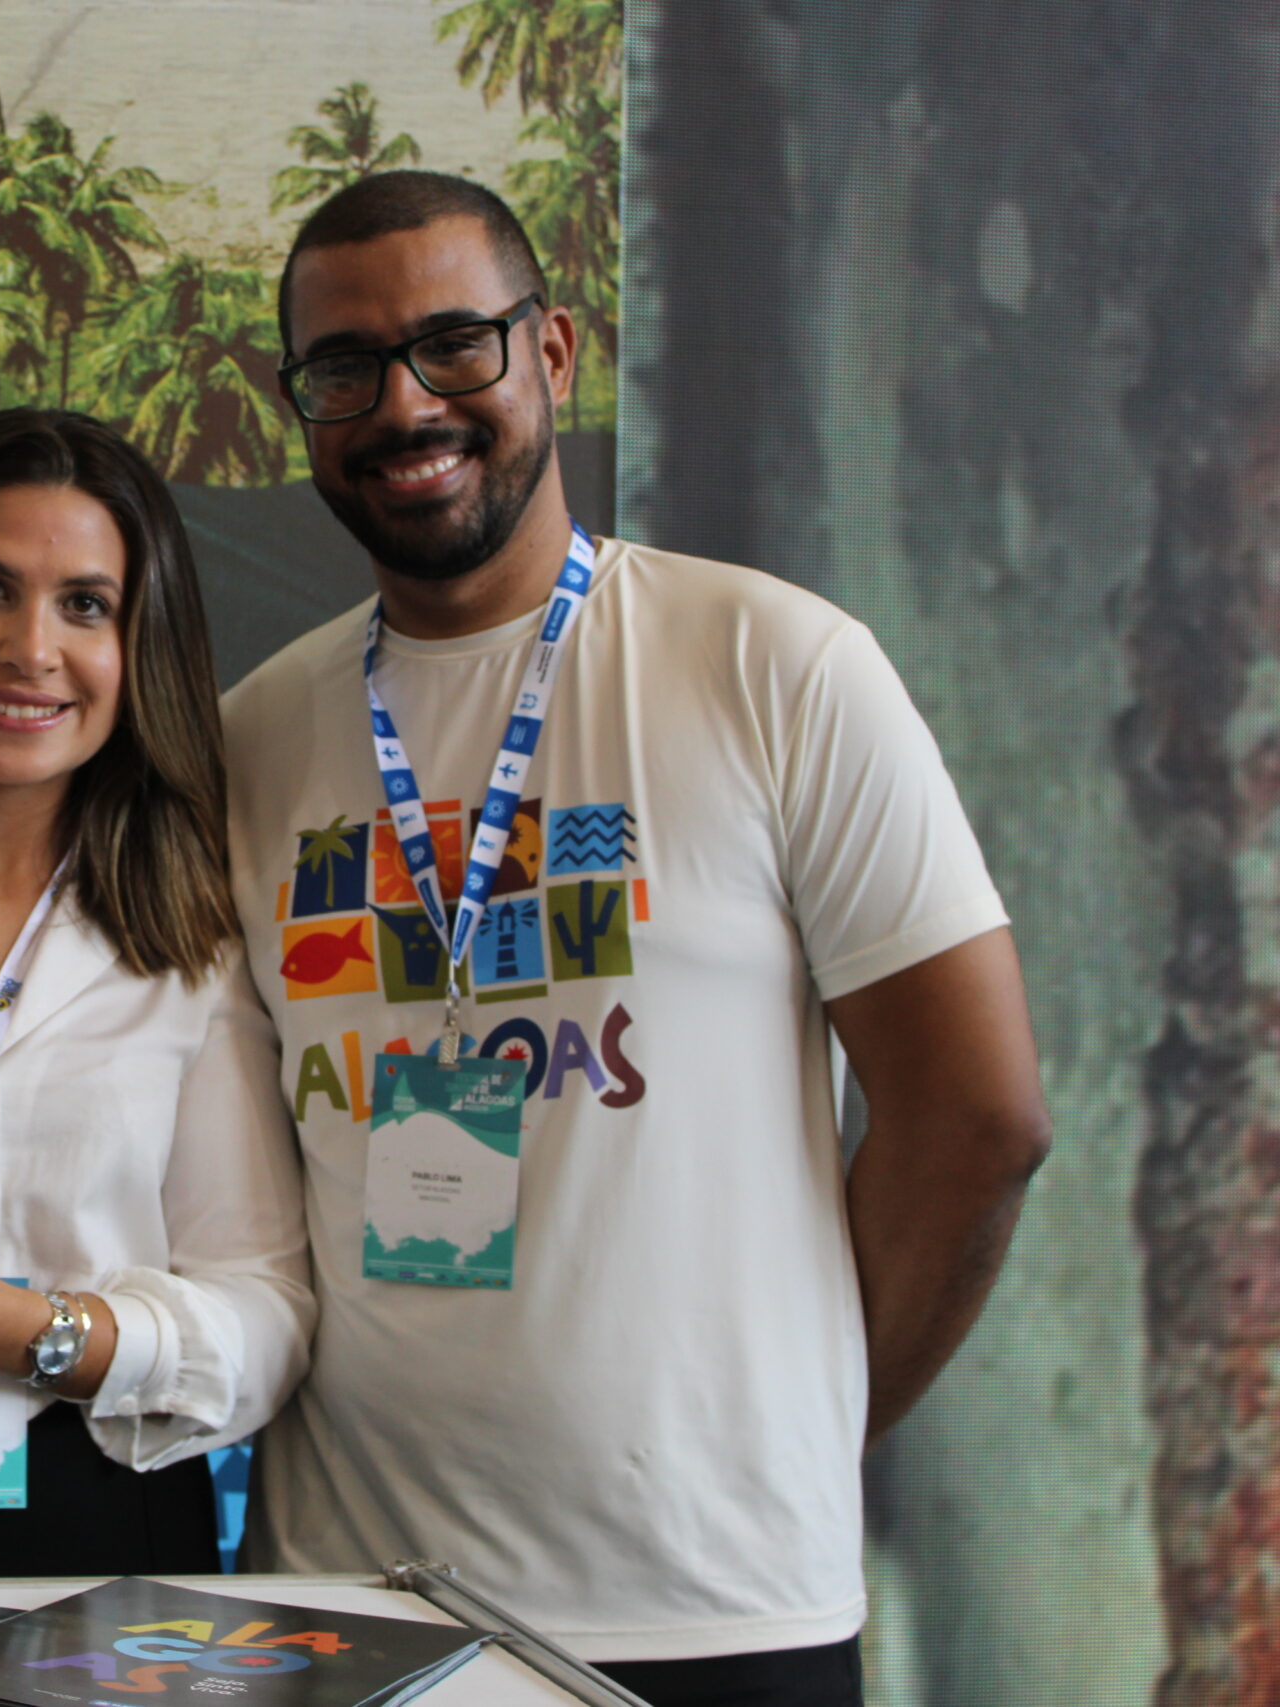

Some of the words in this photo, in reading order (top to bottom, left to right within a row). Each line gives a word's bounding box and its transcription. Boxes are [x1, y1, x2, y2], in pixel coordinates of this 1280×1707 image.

[295, 1002, 646, 1123] ALOAS
[464, 1095, 516, 1107] ALAGOAS
[411, 1171, 440, 1182] PABLO
[441, 1174, 462, 1184] LIMA
[113, 1636, 312, 1675] GO
[118, 1619, 354, 1655] ALA
[22, 1652, 190, 1693] AS
